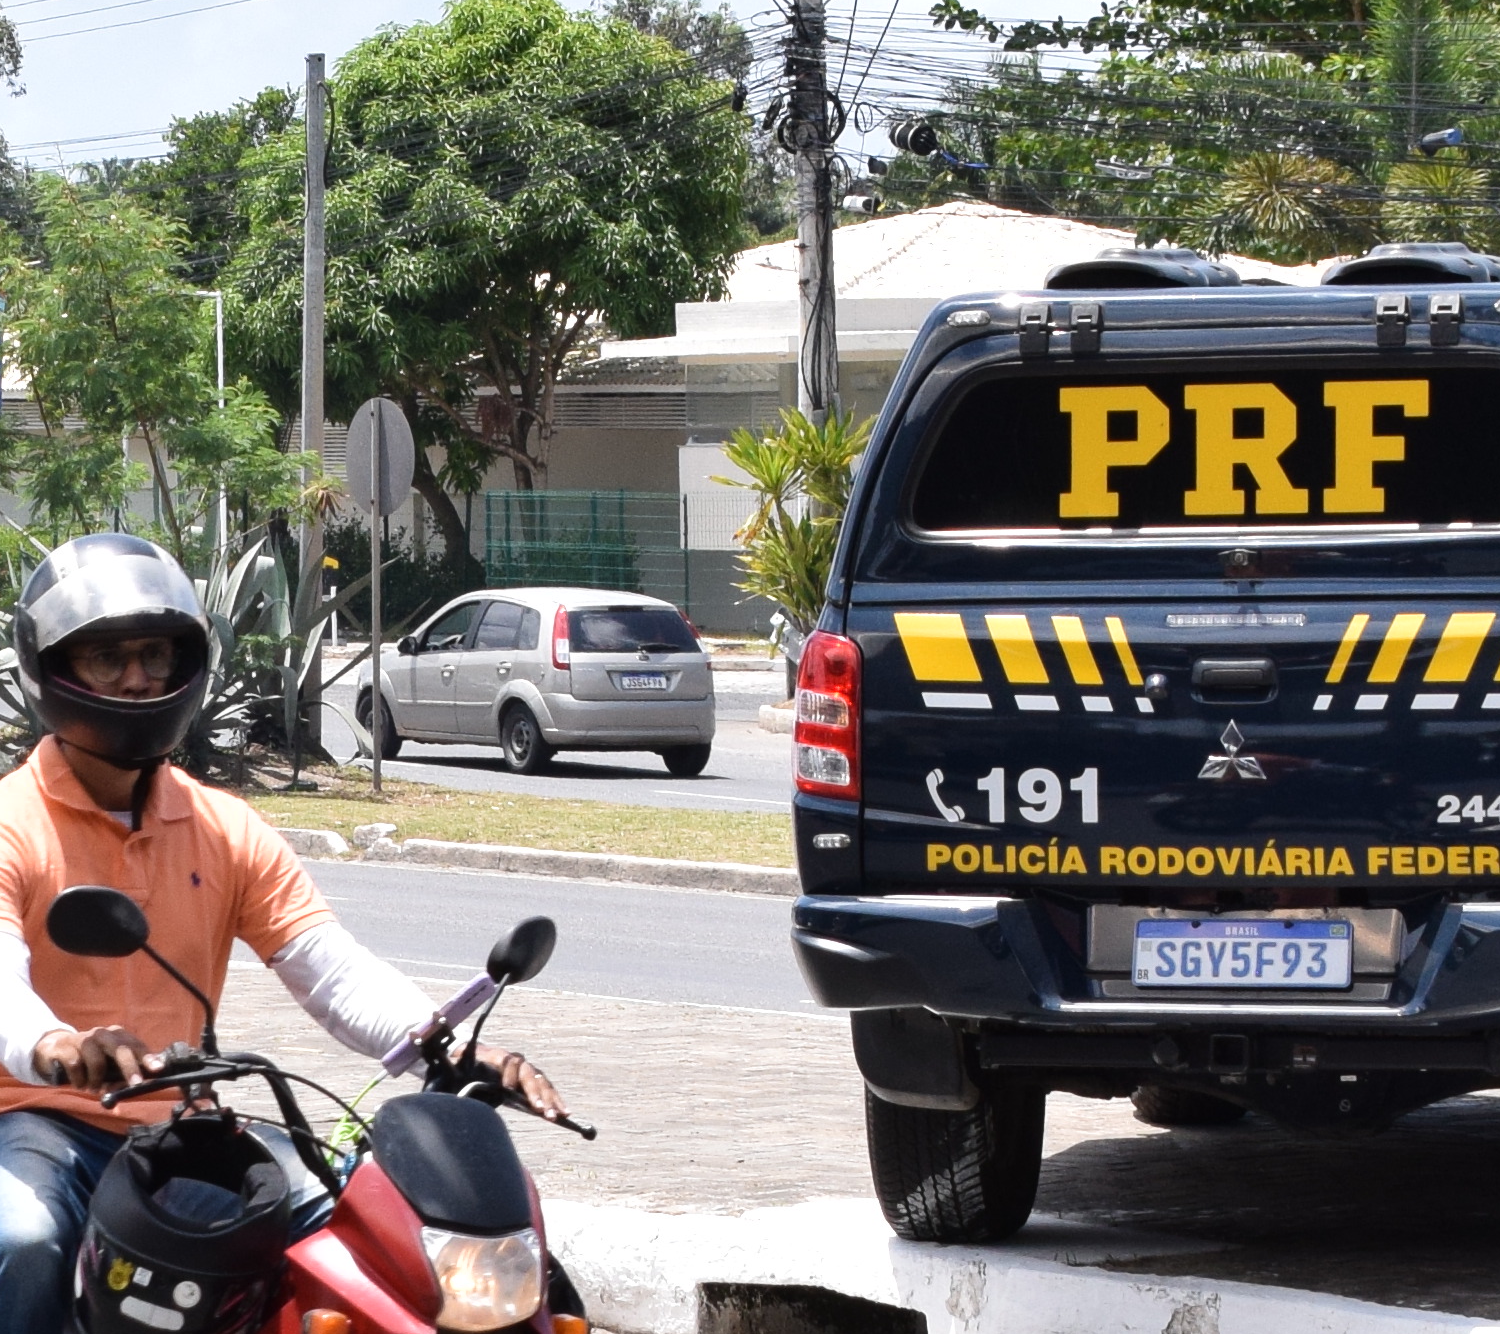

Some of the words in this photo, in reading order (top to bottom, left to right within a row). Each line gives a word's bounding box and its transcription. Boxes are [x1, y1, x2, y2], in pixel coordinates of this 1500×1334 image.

[1059, 380, 1429, 517] PRF
[977, 767, 1099, 824] 191
[1100, 839, 1355, 876] RODOVIÁRIA
[1225, 926, 1259, 937] BRASIL
[1137, 969, 1149, 981] BR
[1155, 941, 1328, 979] SGY5F93
